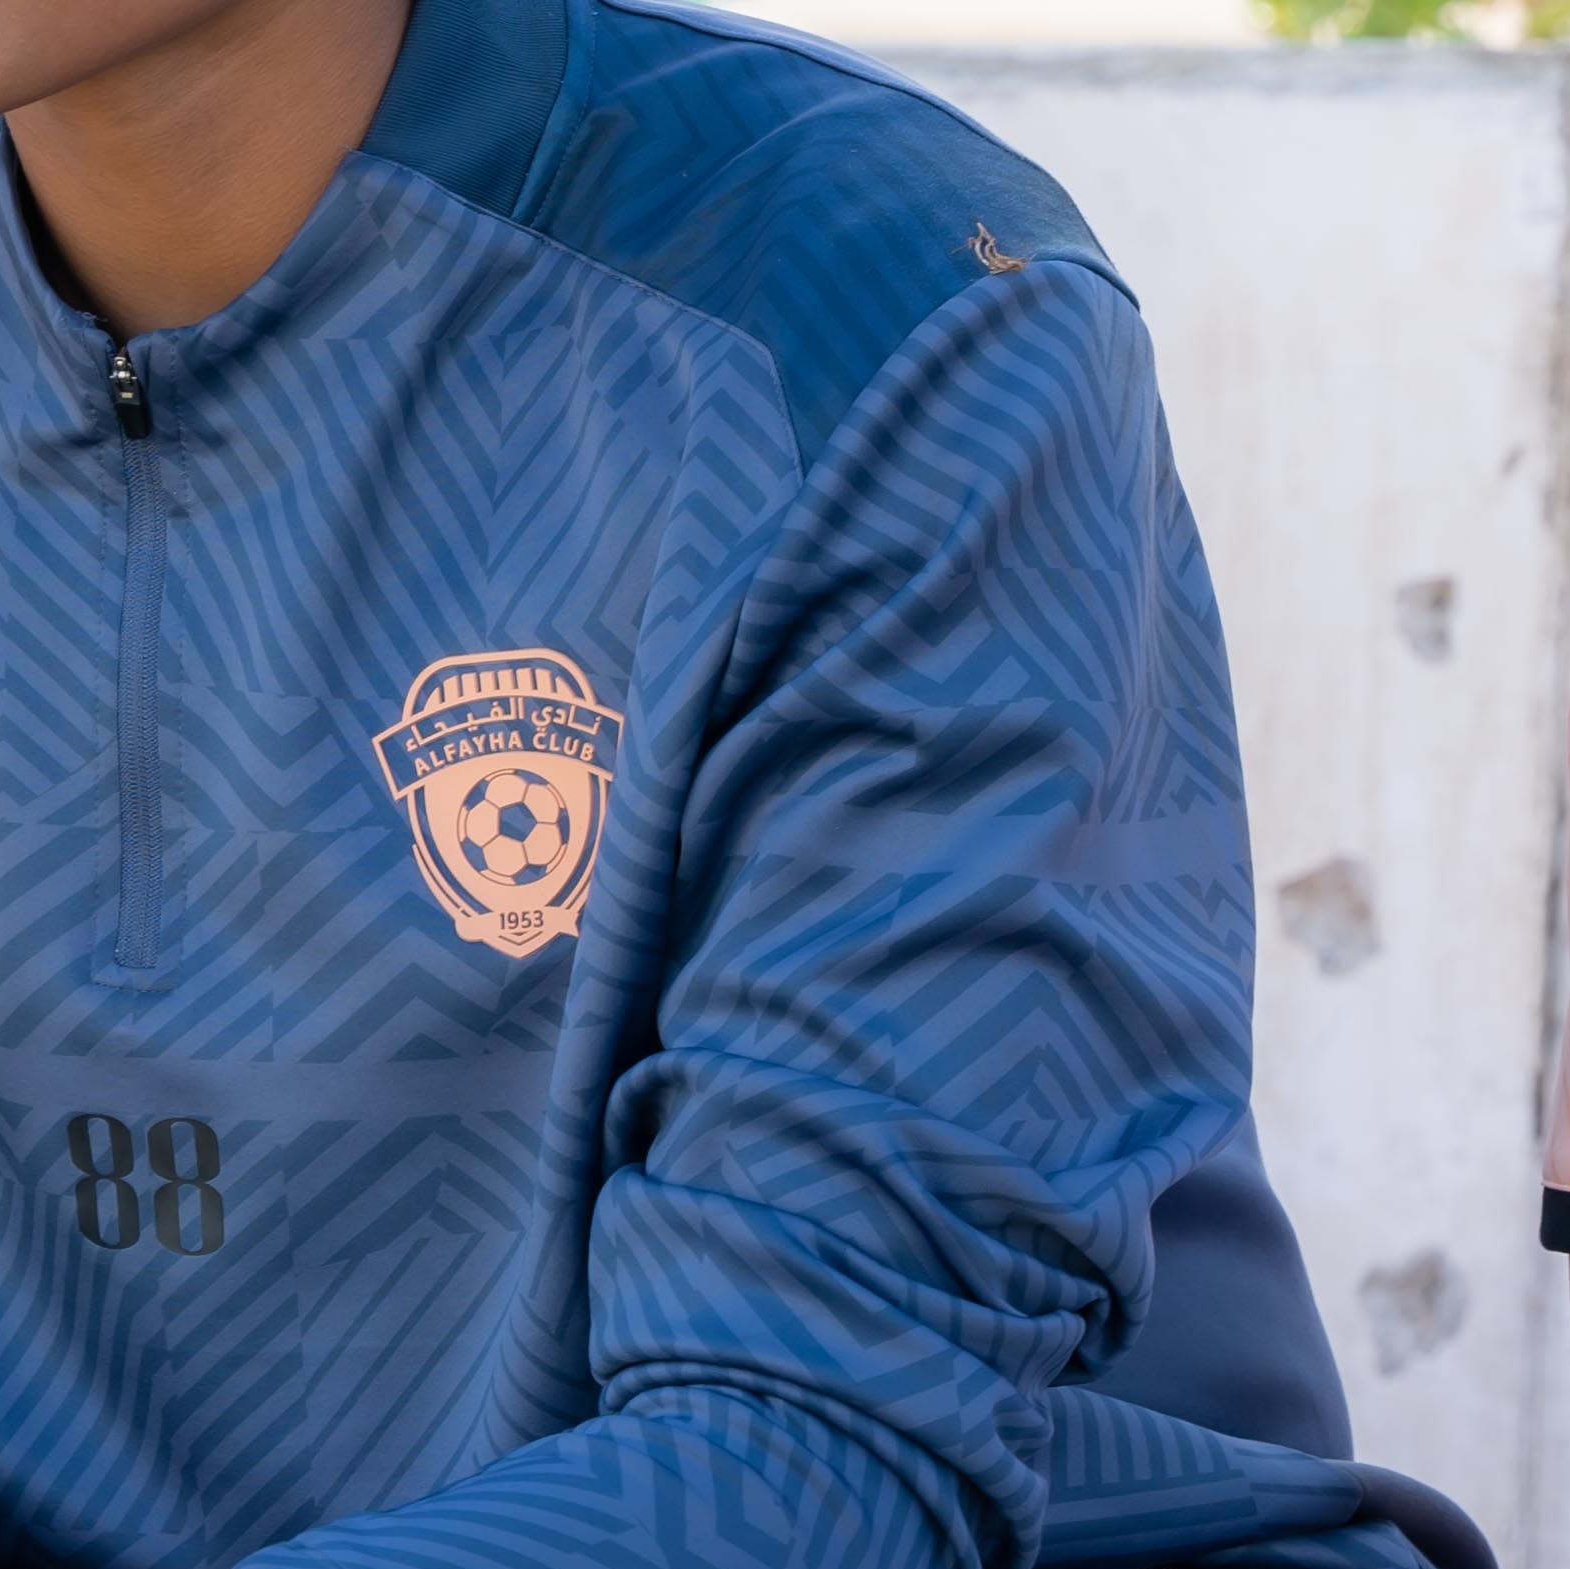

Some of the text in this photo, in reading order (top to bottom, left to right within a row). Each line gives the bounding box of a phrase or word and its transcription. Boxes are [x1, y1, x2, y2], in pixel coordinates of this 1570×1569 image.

[404, 696, 602, 752] نادي الفيحاء
[413, 730, 596, 777] ALFAYHA CLUB
[499, 909, 544, 930] 1953
[66, 1113, 225, 1257] 88
